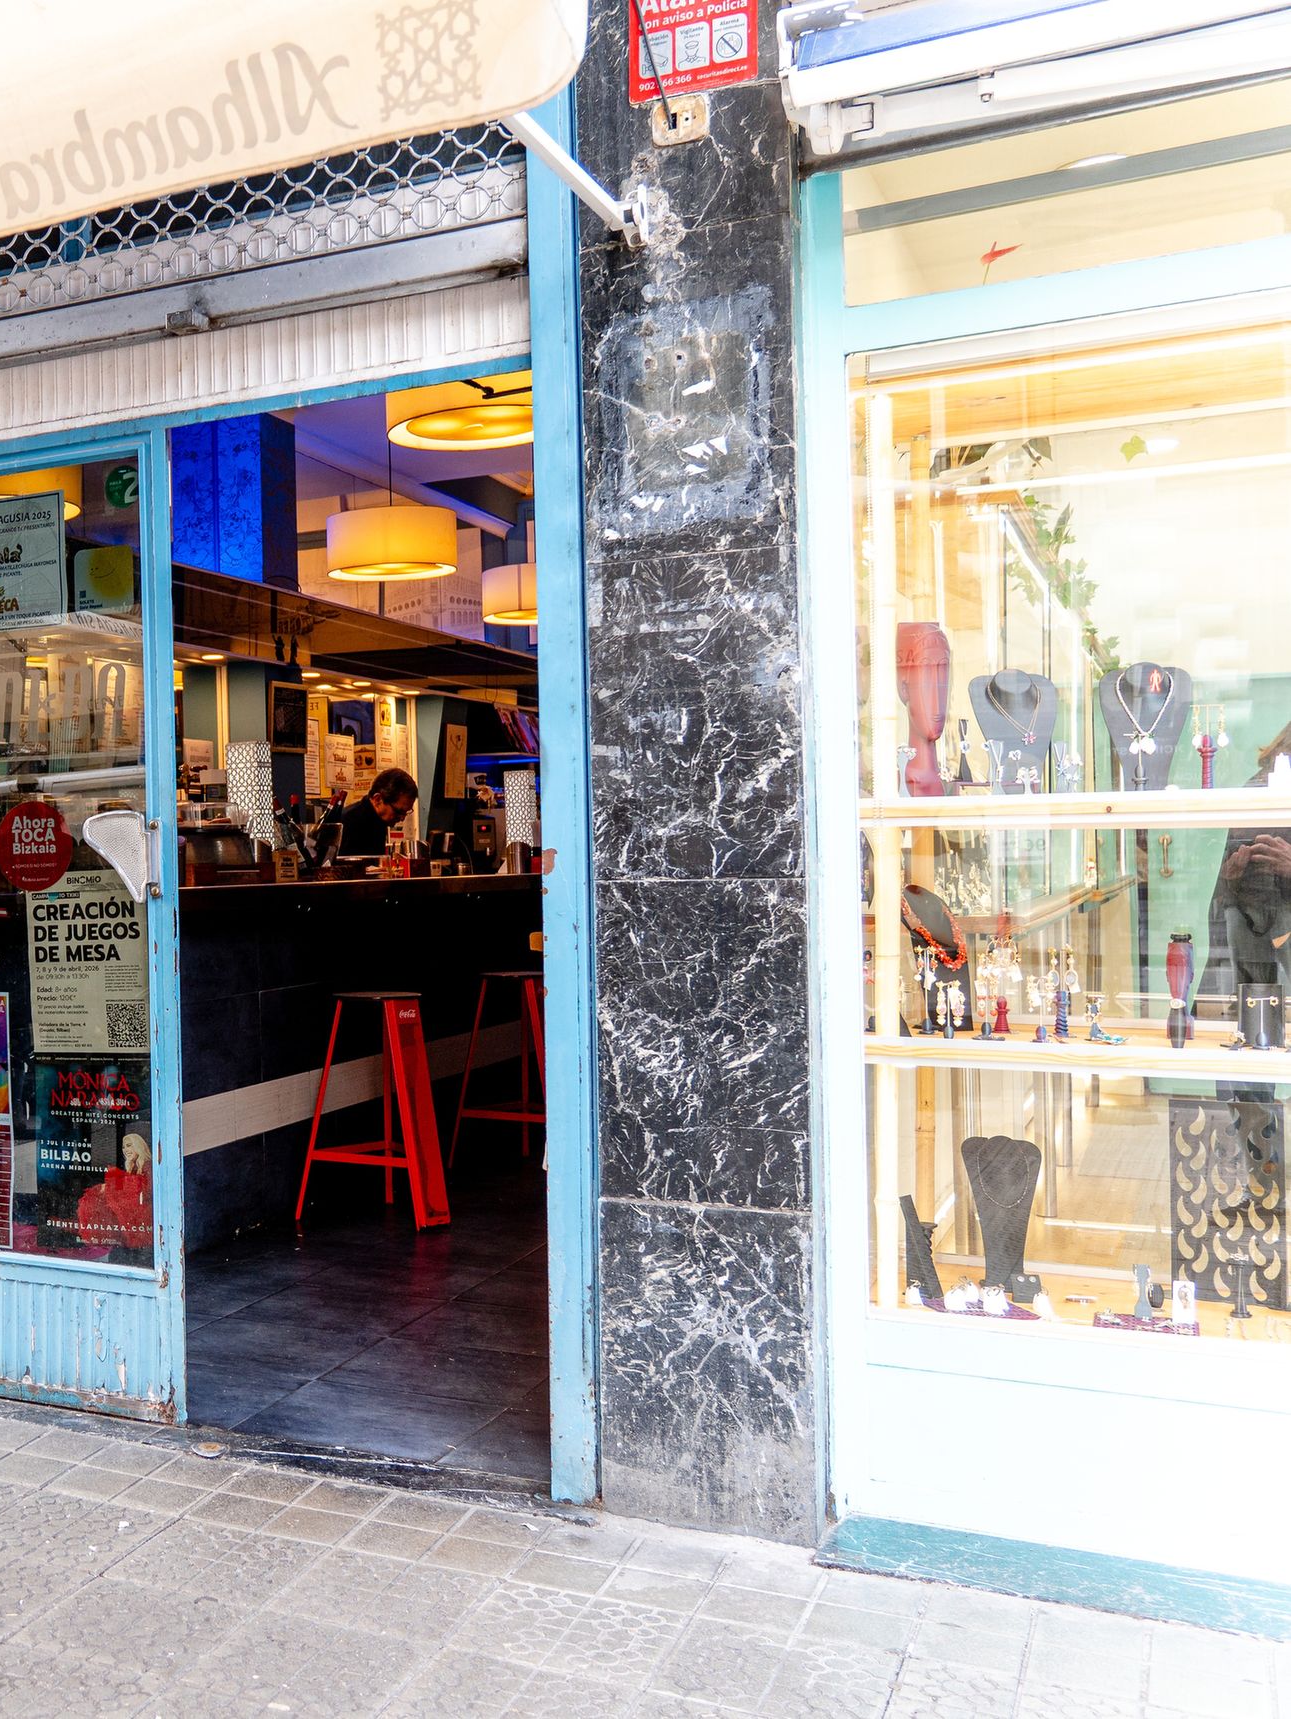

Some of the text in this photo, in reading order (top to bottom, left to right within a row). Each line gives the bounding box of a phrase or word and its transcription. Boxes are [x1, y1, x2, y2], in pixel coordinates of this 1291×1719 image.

[662, 11, 693, 25] aviso
[696, 8, 704, 17] a
[638, 82, 655, 92] 902
[675, 74, 692, 84] 366
[31, 510, 52, 521] 2025
[12, 816, 55, 829] Ahora
[12, 828, 55, 843] TOCA
[13, 841, 57, 855] Bizkaia
[33, 896, 136, 921] CREACIÓN
[34, 922, 140, 942] DE JUEGOS
[35, 944, 121, 963] DE MESA
[40, 1148, 92, 1163] BILBAO
